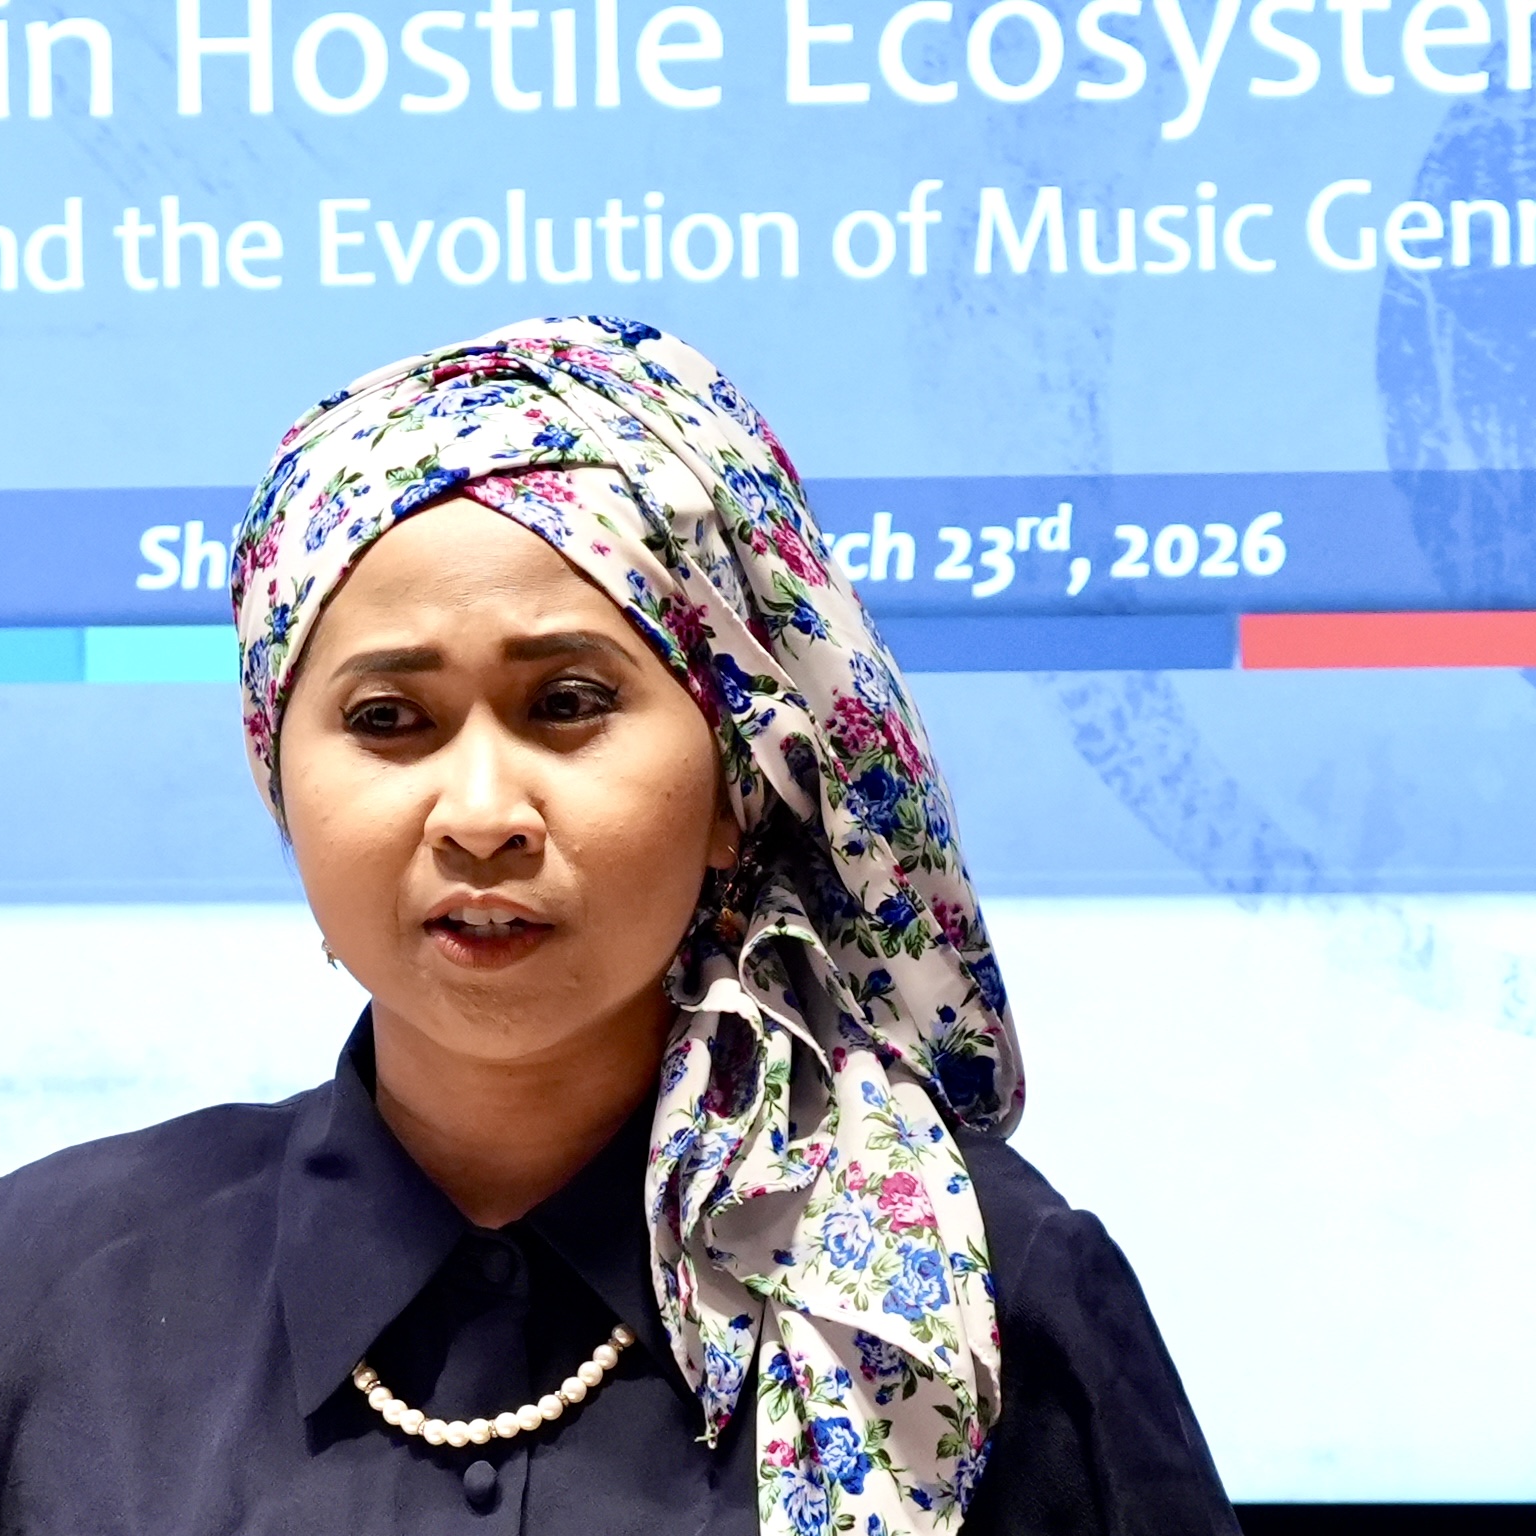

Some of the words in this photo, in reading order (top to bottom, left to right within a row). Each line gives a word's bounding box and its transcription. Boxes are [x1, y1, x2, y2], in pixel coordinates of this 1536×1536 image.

[175, 0, 725, 116] Hostile
[114, 195, 284, 291] the
[318, 189, 800, 287] Evolution
[832, 179, 943, 280] of
[972, 181, 1278, 276] Music
[1110, 512, 1287, 578] 2026
